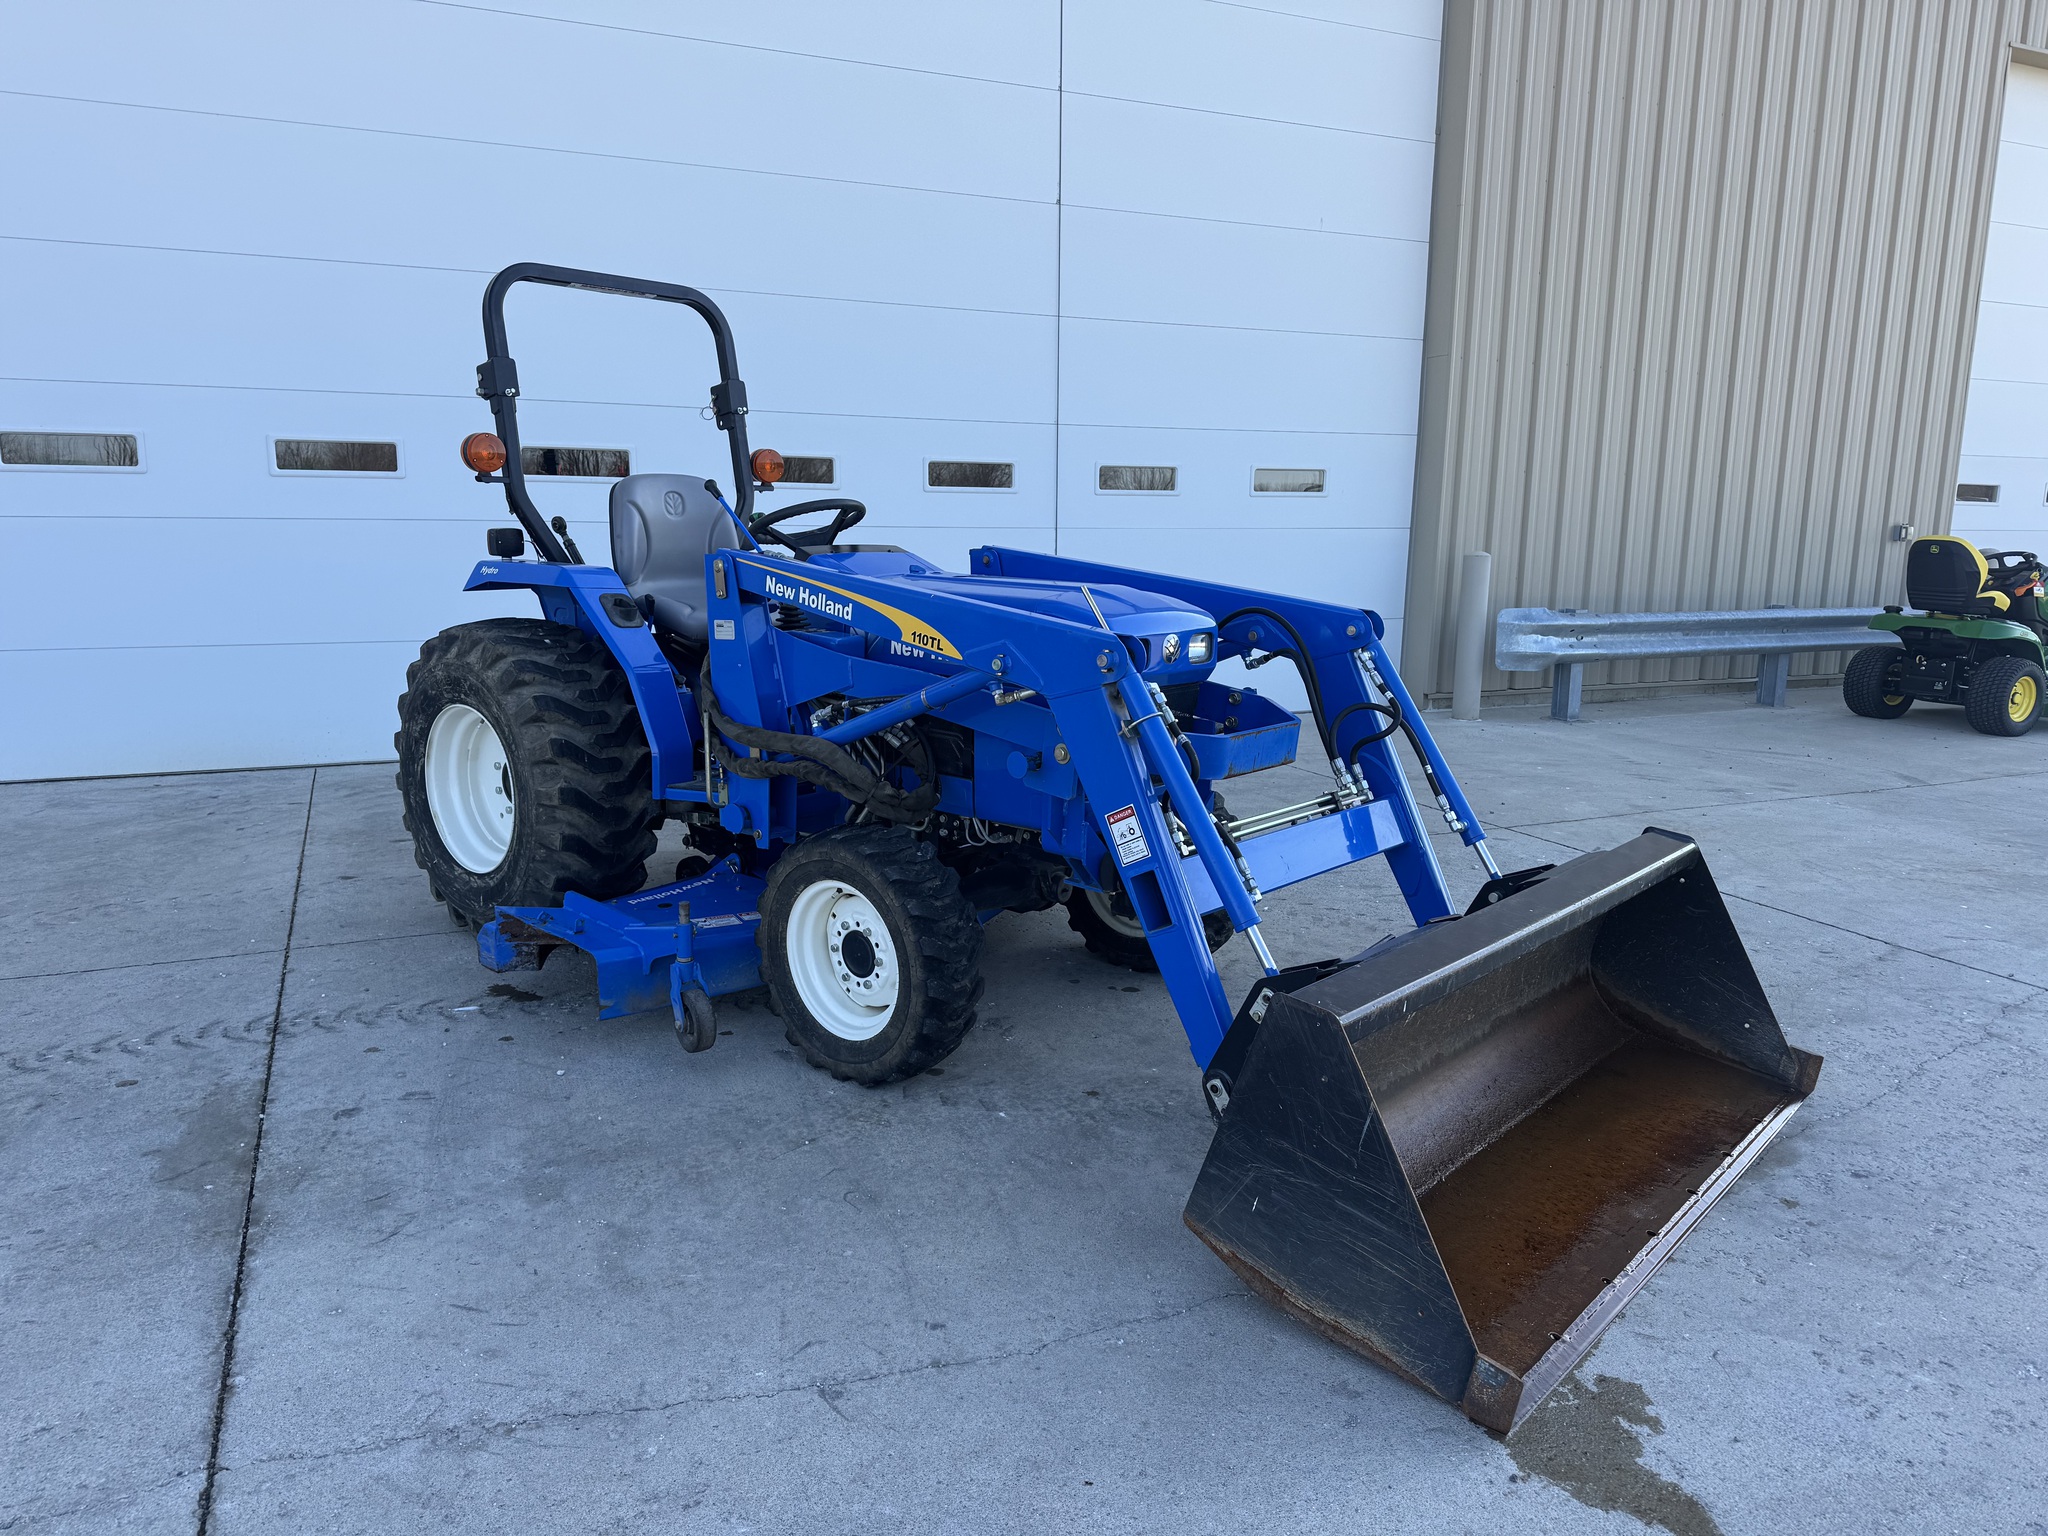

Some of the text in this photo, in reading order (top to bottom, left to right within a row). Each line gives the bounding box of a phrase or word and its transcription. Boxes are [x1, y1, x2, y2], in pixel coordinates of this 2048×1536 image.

[480, 566, 499, 575] Hydro
[766, 575, 853, 621] New Holland
[890, 640, 925, 658] New
[911, 631, 944, 651] 110TL
